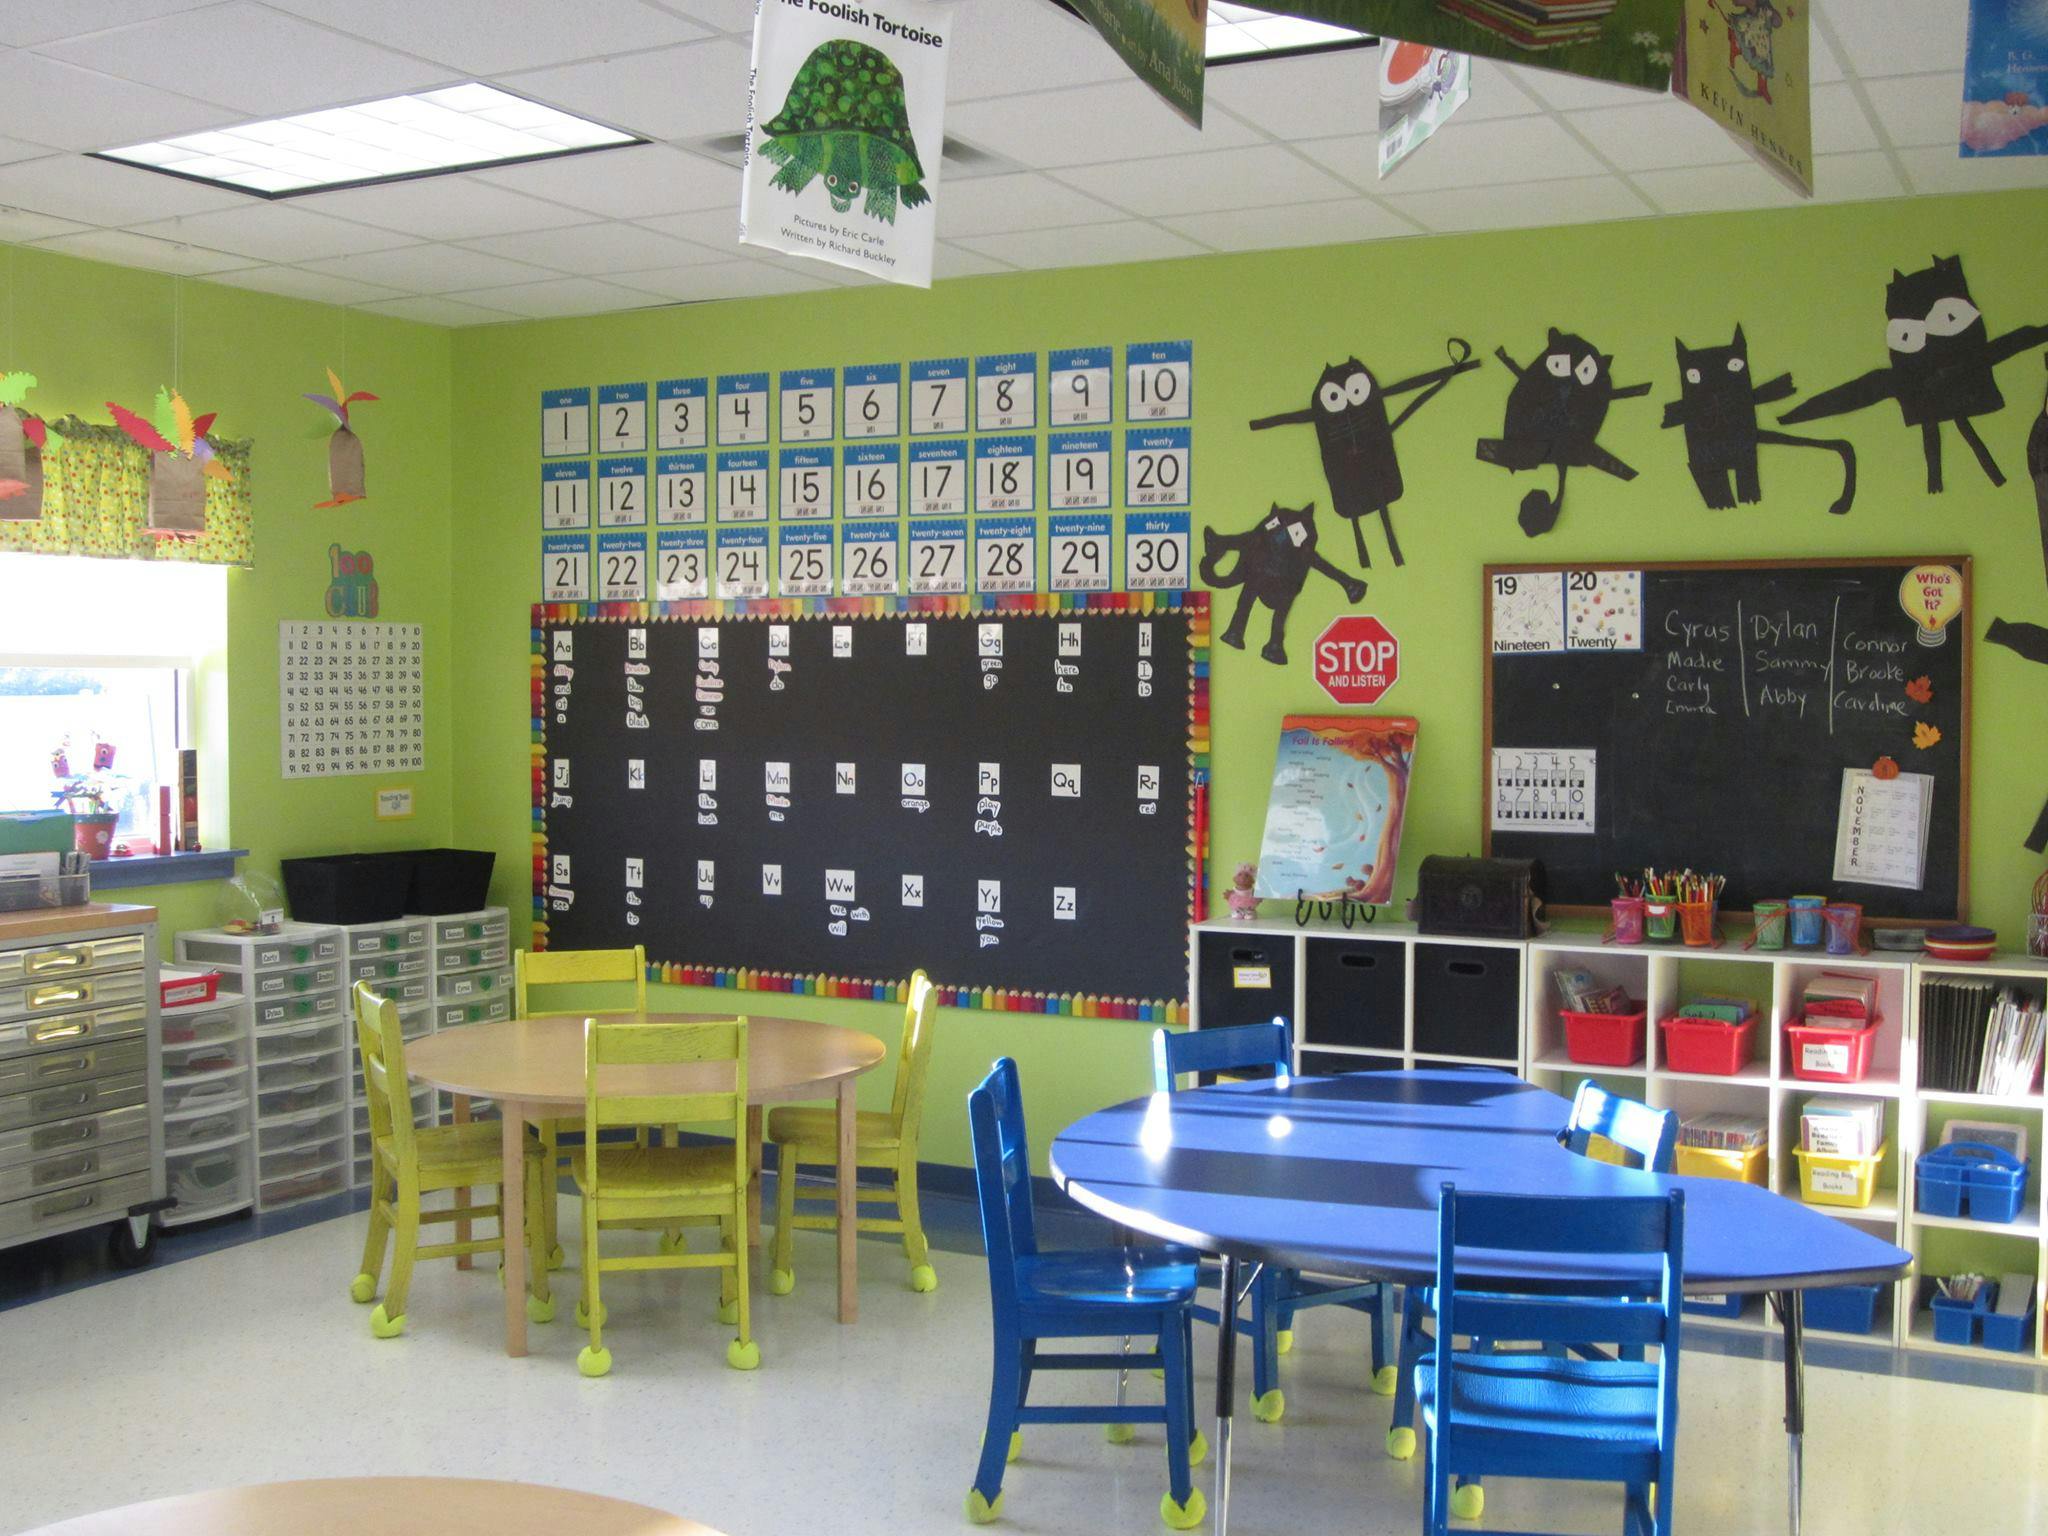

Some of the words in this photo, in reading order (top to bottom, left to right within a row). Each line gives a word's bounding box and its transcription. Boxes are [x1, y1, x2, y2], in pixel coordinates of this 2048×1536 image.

[809, 0, 869, 26] Foolish
[873, 13, 942, 47] Tortoise
[1149, 48, 1170, 82] Ana
[1700, 82, 1743, 127] KEVIN
[794, 215, 827, 232] Pictures
[830, 224, 839, 236] by
[842, 226, 857, 239] Eric
[861, 232, 884, 246] Carle
[781, 228, 813, 244] Written
[817, 237, 826, 248] by
[829, 241, 860, 257] Richard
[863, 250, 896, 265] Buckley
[1072, 358, 1089, 366] nine
[1152, 351, 1166, 360] ten
[928, 368, 950, 376] seven
[996, 362, 1016, 372] eight
[866, 373, 877, 381] six
[735, 382, 750, 390] four
[1071, 374, 1089, 407] 9
[1141, 368, 1177, 403] 10
[616, 392, 629, 400] two
[930, 384, 947, 417] 7
[996, 379, 1015, 412] 8
[798, 393, 815, 424] 5
[862, 389, 880, 420] 6
[674, 403, 689, 432] 3
[734, 398, 750, 428] 4
[564, 411, 568, 440] 1
[615, 407, 629, 437] 2
[1062, 441, 1098, 450] nineteen
[1143, 437, 1174, 448] twenty
[918, 450, 957, 458] seventeen
[988, 445, 1022, 455] eighteen
[728, 459, 758, 468] fourteen
[794, 456, 818, 464] fifteen
[858, 453, 885, 462] sixteen
[668, 462, 694, 470] thirteen
[1137, 454, 1179, 489] 20
[923, 465, 952, 498] 17
[989, 461, 1020, 495] 18
[1066, 458, 1094, 491] 19
[730, 475, 756, 506] 14
[792, 472, 819, 503] 15
[858, 469, 885, 500] 16
[556, 484, 576, 514] 11
[610, 481, 634, 511] 12
[669, 478, 694, 508] 13
[912, 527, 964, 538] twenty-seven
[980, 525, 1032, 537] twenty-eight
[1055, 523, 1105, 534] twenty-nine
[1146, 520, 1170, 532] thirty
[722, 536, 763, 545] twenty-four
[785, 533, 827, 543] twenty-five
[851, 530, 890, 540] twenty-six
[548, 542, 584, 552] twenty-one
[603, 541, 641, 550] twenty-two
[661, 538, 704, 547] twenty-three
[852, 546, 888, 578] 26
[919, 544, 955, 577] 27
[987, 542, 1025, 576] 28
[1062, 541, 1099, 574] 29
[1136, 539, 1179, 572] 30
[556, 557, 578, 587] 21
[607, 556, 637, 586] 22
[666, 554, 698, 583] 23
[726, 551, 759, 582] 24
[790, 549, 824, 581] 25
[1495, 576, 1517, 595] 19
[1570, 571, 1597, 590] 20
[1916, 574, 1950, 584] Who's
[1923, 587, 1942, 597] Got
[1924, 600, 1940, 610] It?
[1665, 610, 1729, 647] Cyrus
[1751, 610, 1817, 646] Dylan
[555, 640, 571, 652] Aa
[630, 637, 644, 650] Bb
[771, 634, 787, 648] Dd
[981, 632, 1001, 653] Gg
[1060, 632, 1078, 647] Hh
[1141, 632, 1150, 647] Ii
[1494, 640, 1549, 651] Nineteen
[1569, 636, 1616, 650] Twenty
[1844, 632, 1908, 653] Connor
[1319, 641, 1395, 674] STOP
[1667, 652, 1724, 671] Madie
[982, 660, 1001, 670] green
[1056, 661, 1078, 674] here
[1756, 650, 1833, 682] Sammy
[1846, 660, 1904, 683] Brooke
[556, 683, 571, 693] and
[772, 679, 782, 689] do
[986, 676, 998, 688] go
[1059, 678, 1072, 691] he
[1328, 675, 1349, 687] AND
[1352, 675, 1386, 687] LISTEN
[1140, 682, 1151, 695] is
[1667, 675, 1710, 707] Carly
[1760, 685, 1807, 719] Abby
[1291, 736, 1309, 745] Fall
[1312, 737, 1320, 745] Is
[1322, 737, 1354, 747] Falling
[556, 767, 569, 786] Jj
[767, 772, 788, 784] Mm
[837, 772, 854, 786] Nn
[904, 772, 923, 787] Oo
[981, 771, 997, 792] Pp
[1140, 774, 1157, 790] Rr
[1053, 773, 1079, 795] Qq
[700, 795, 714, 807] like
[903, 800, 928, 812] orange
[980, 800, 998, 814] play
[1141, 803, 1156, 814] red
[700, 813, 716, 823] look
[771, 812, 783, 820] me
[977, 821, 1001, 834] purple
[556, 863, 568, 876] Ss
[628, 866, 641, 880] Tt
[699, 868, 714, 883] Uu
[764, 873, 780, 886] Vv
[827, 878, 853, 892] Ww
[904, 883, 921, 898] Xx
[628, 893, 640, 904] the
[981, 888, 998, 909] Yy
[1056, 896, 1073, 911] Zz
[832, 906, 845, 914] we
[852, 910, 869, 919] with
[628, 913, 638, 923] to
[978, 917, 1002, 928] yellow
[981, 936, 998, 945] you
